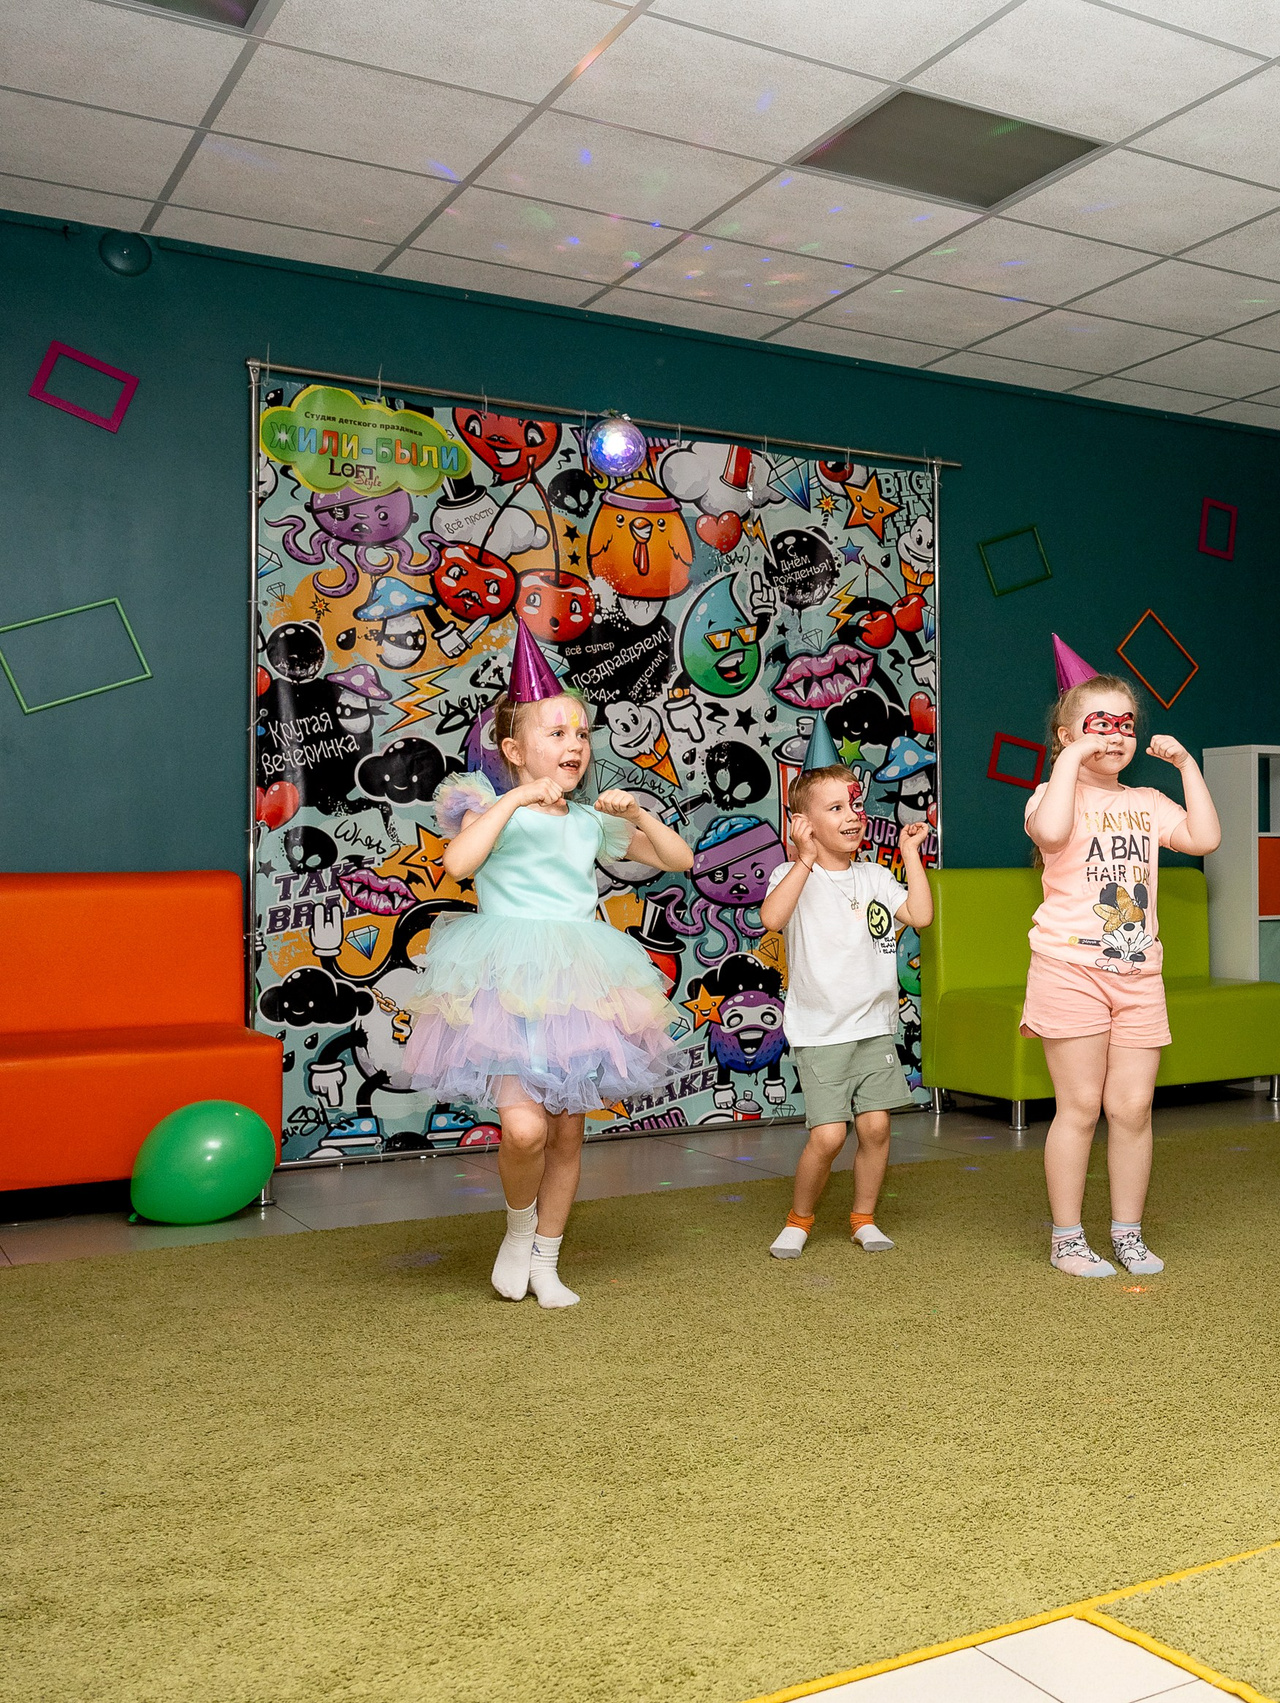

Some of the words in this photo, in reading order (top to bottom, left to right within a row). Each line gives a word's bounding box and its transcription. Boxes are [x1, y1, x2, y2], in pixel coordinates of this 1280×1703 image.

[304, 411, 336, 423] Студия
[338, 416, 378, 429] детского
[379, 423, 423, 437] праздника
[269, 421, 459, 471] ЖИЛИ-БЫЛИ
[328, 458, 377, 480] LOFT
[354, 472, 382, 490] Style
[464, 507, 494, 526] просто
[585, 641, 615, 654] супер
[268, 712, 333, 748] Крутая
[1085, 810, 1151, 832] HAVING
[1085, 836, 1105, 862] A
[1111, 834, 1150, 863] BAD
[1086, 864, 1127, 882] HAIR
